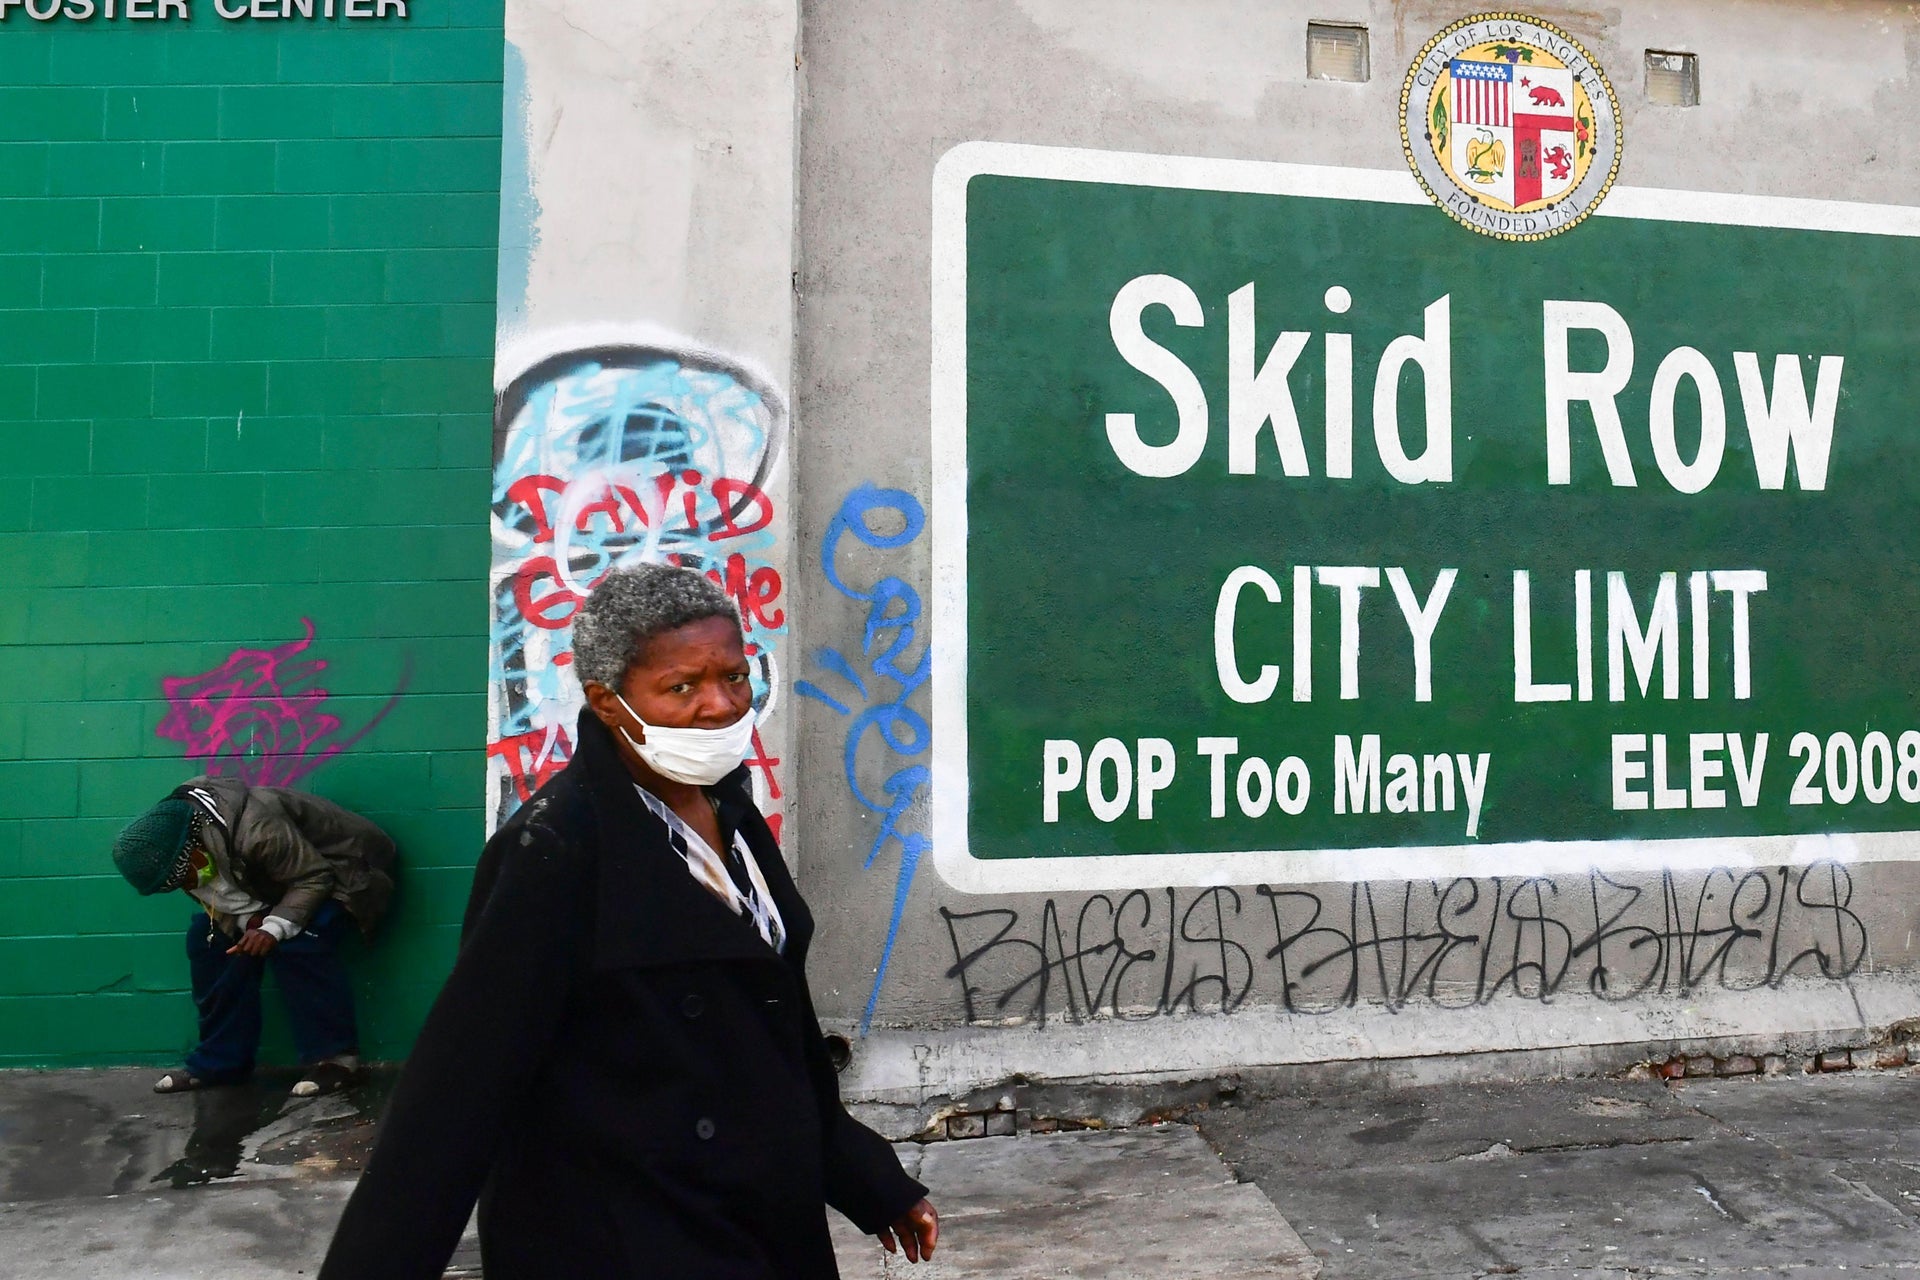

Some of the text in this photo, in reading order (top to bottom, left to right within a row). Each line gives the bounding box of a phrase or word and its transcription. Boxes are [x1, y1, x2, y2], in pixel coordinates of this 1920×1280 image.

[1417, 24, 1605, 101] CITY OF LOS ANGELES
[1447, 191, 1579, 232] FOUNDED 1781
[1104, 273, 1845, 495] Skid Row
[1213, 565, 1767, 703] CITY LIMIT
[1043, 733, 1491, 837] POP Too Many
[1611, 730, 1920, 811] ELEV 2008
